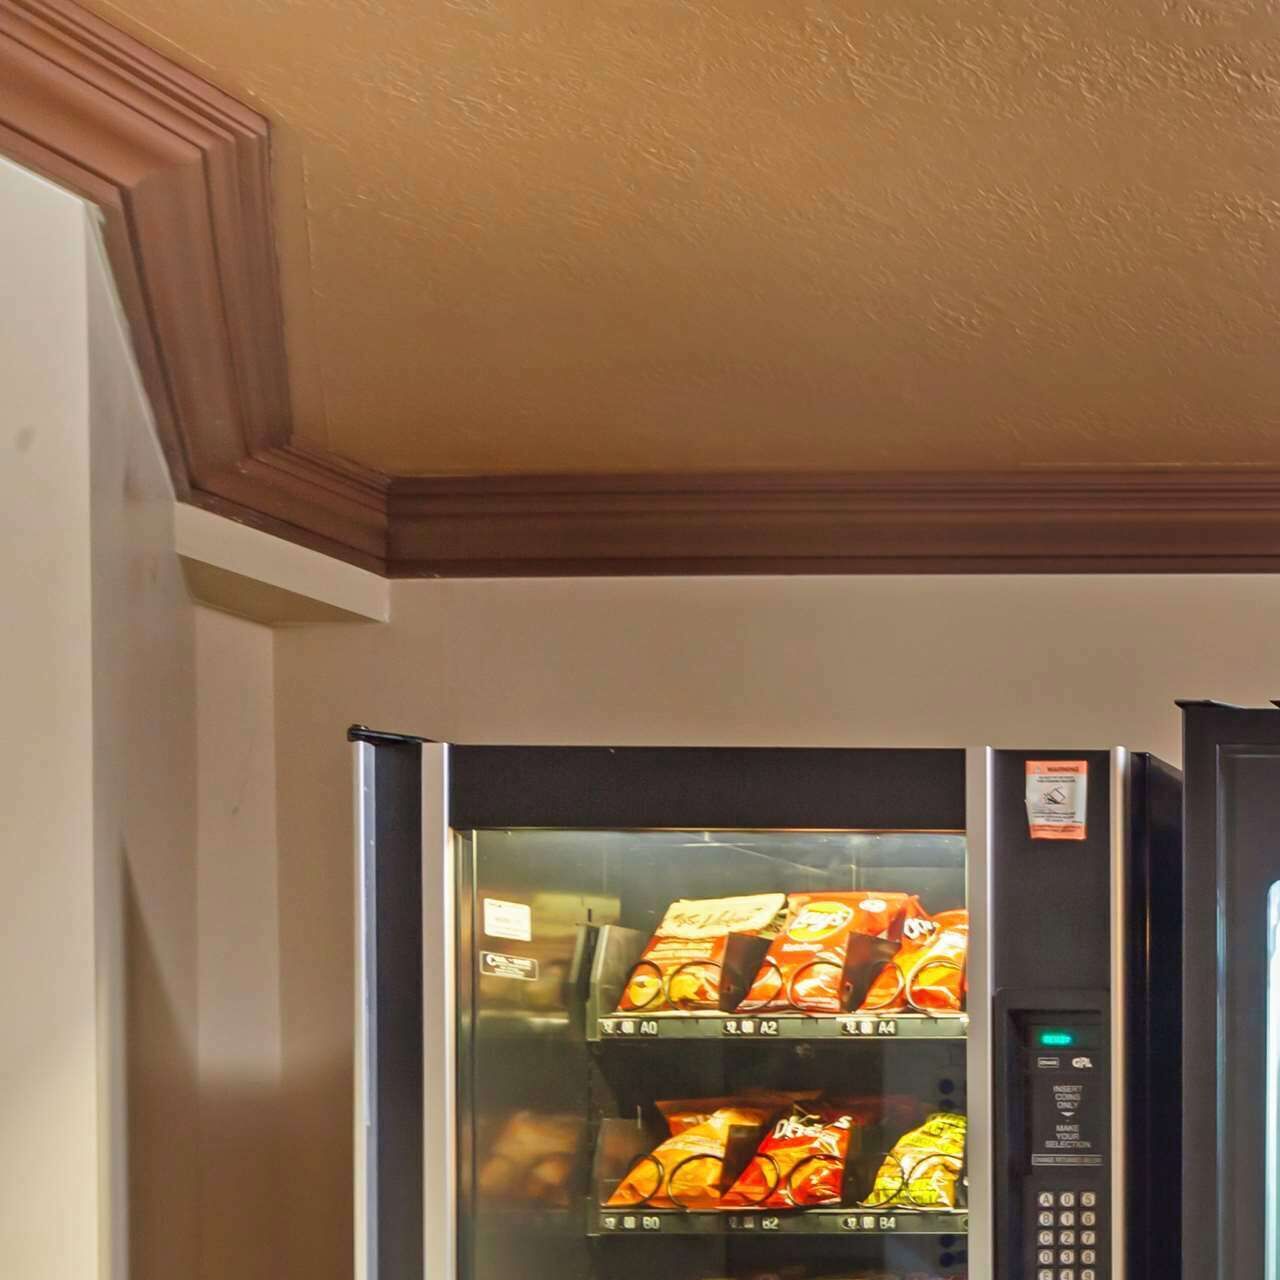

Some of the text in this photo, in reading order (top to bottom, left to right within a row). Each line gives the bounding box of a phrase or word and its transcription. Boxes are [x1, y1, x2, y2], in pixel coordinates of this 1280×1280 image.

[760, 1021, 778, 1035] A2
[878, 1020, 897, 1034] A4
[880, 1216, 897, 1229] B4
